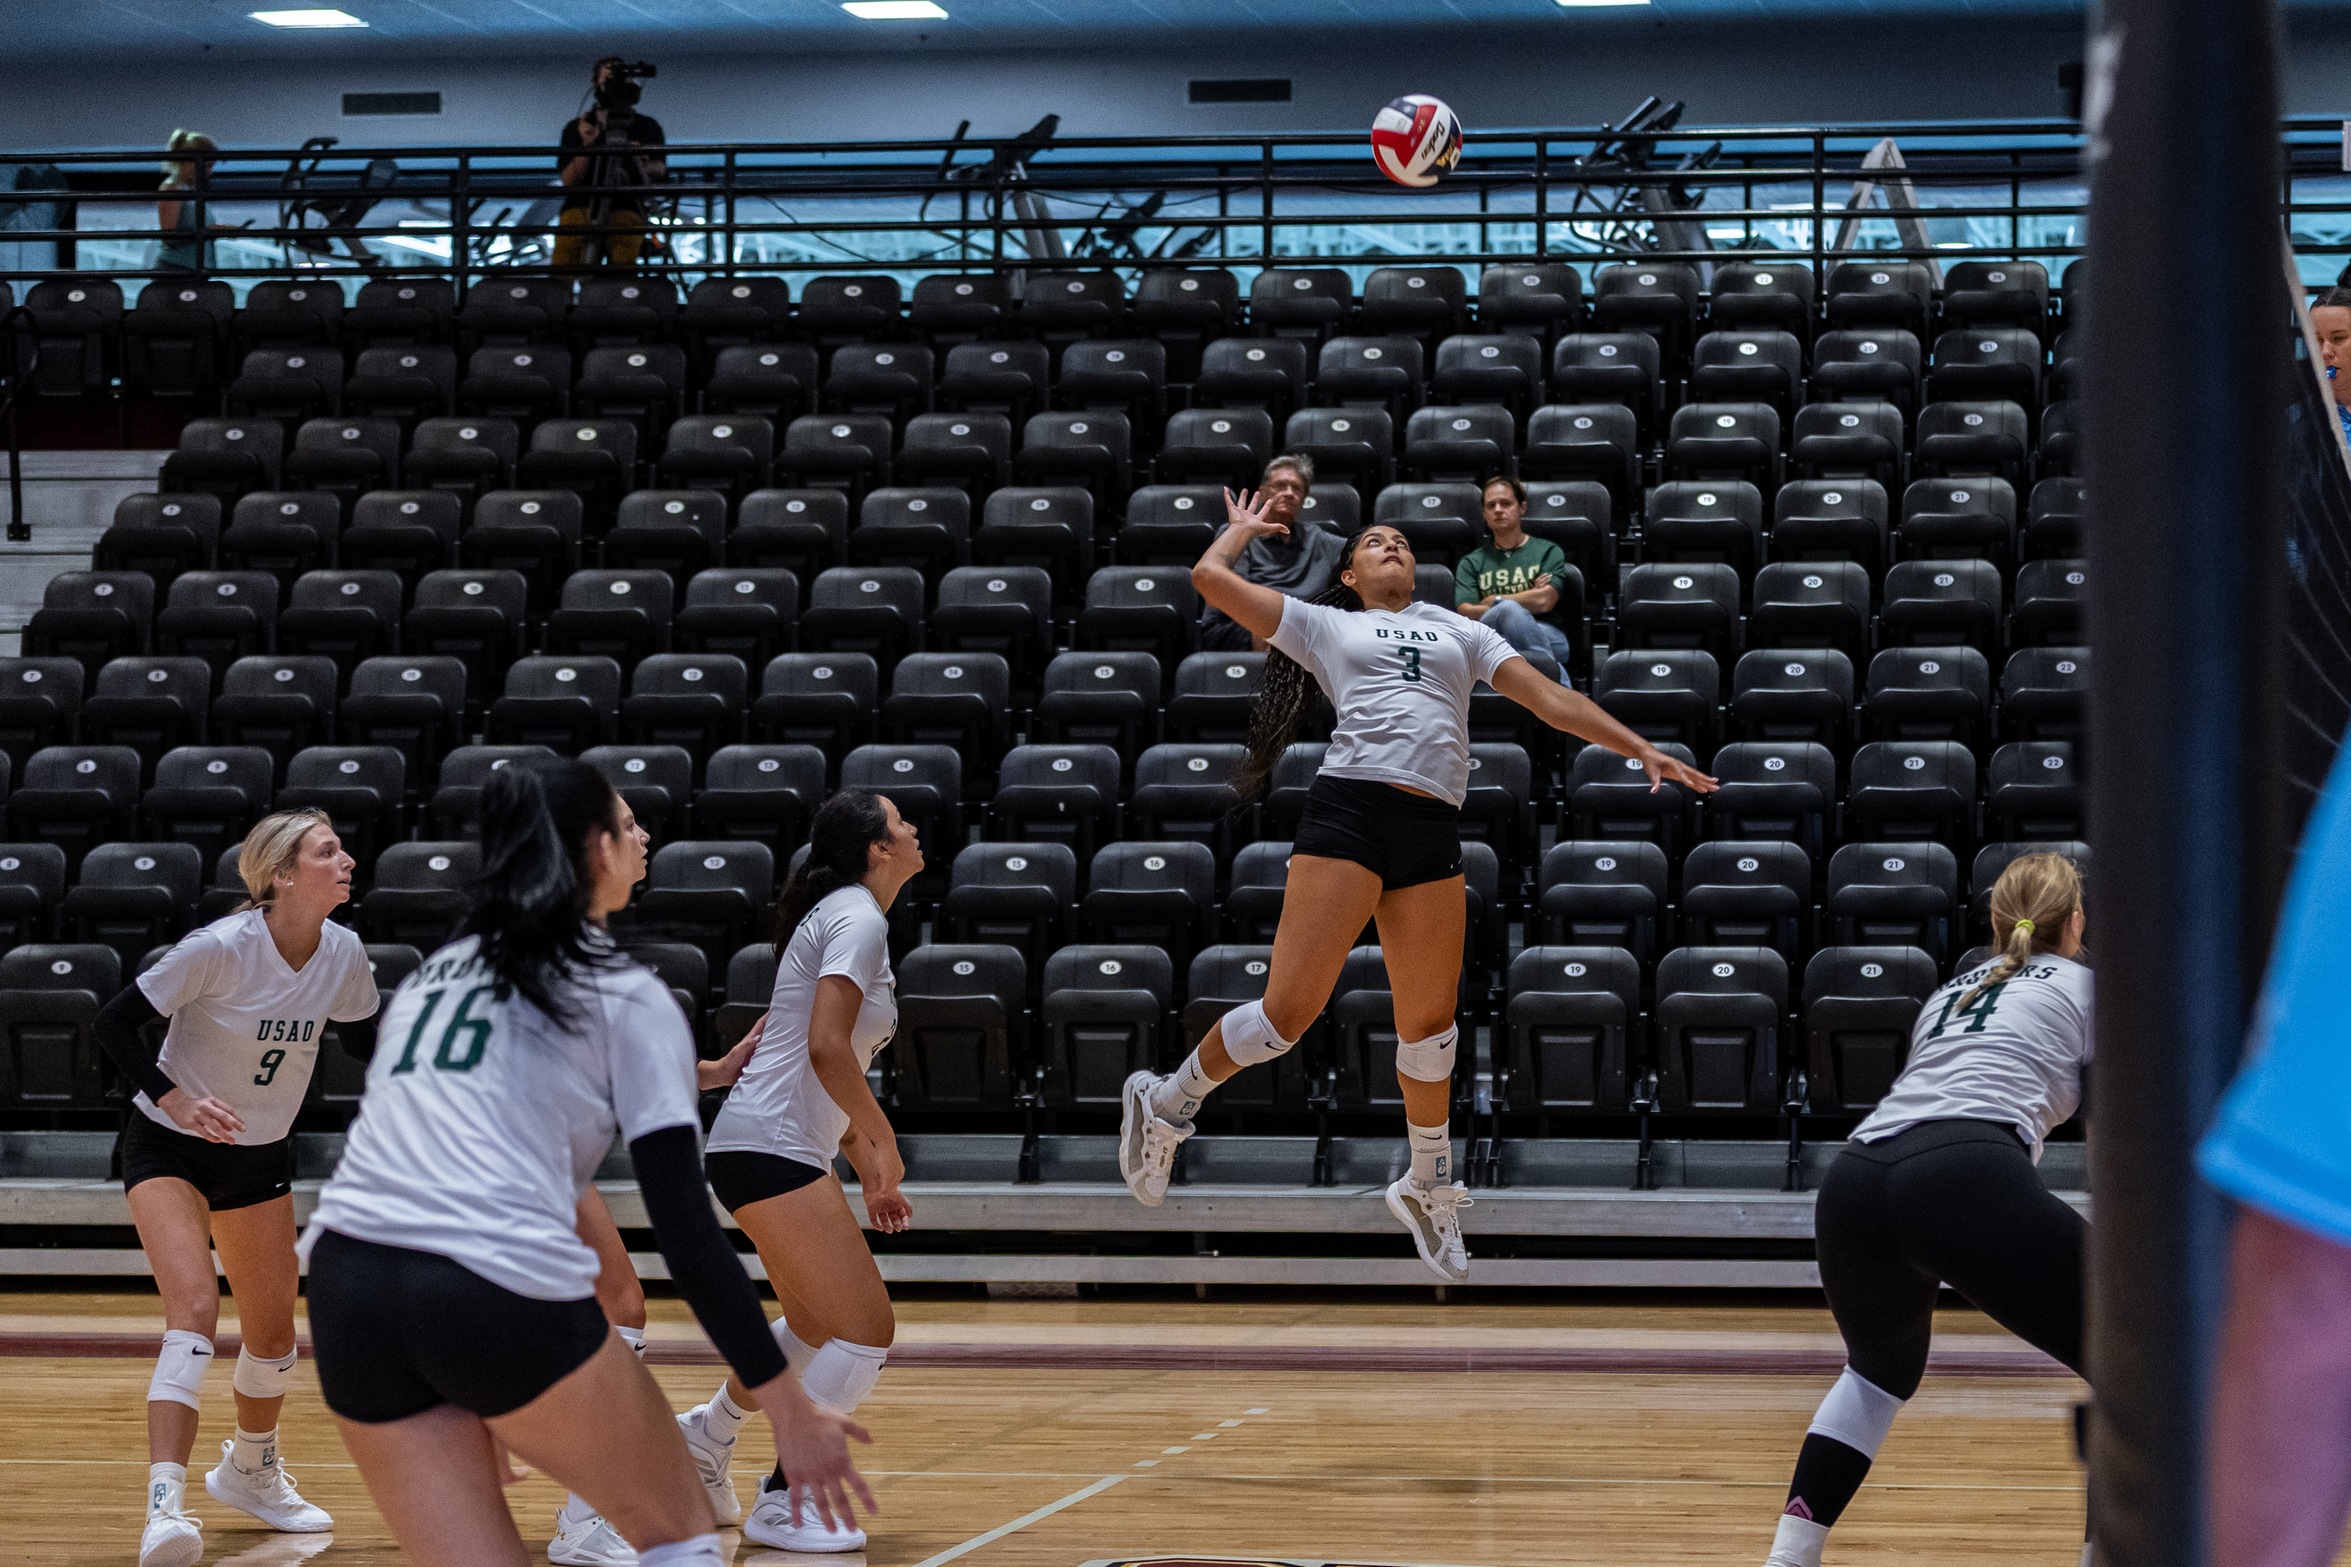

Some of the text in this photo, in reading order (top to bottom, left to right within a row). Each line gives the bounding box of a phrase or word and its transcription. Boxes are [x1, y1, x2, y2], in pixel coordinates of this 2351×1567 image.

[1375, 628, 1439, 642] USAO
[1398, 646, 1422, 682] 3
[1940, 964, 2058, 993] RORS
[1927, 981, 2009, 1041] 14
[257, 1019, 315, 1042] USAO
[390, 983, 500, 1077] 16
[253, 1049, 287, 1087] 9
